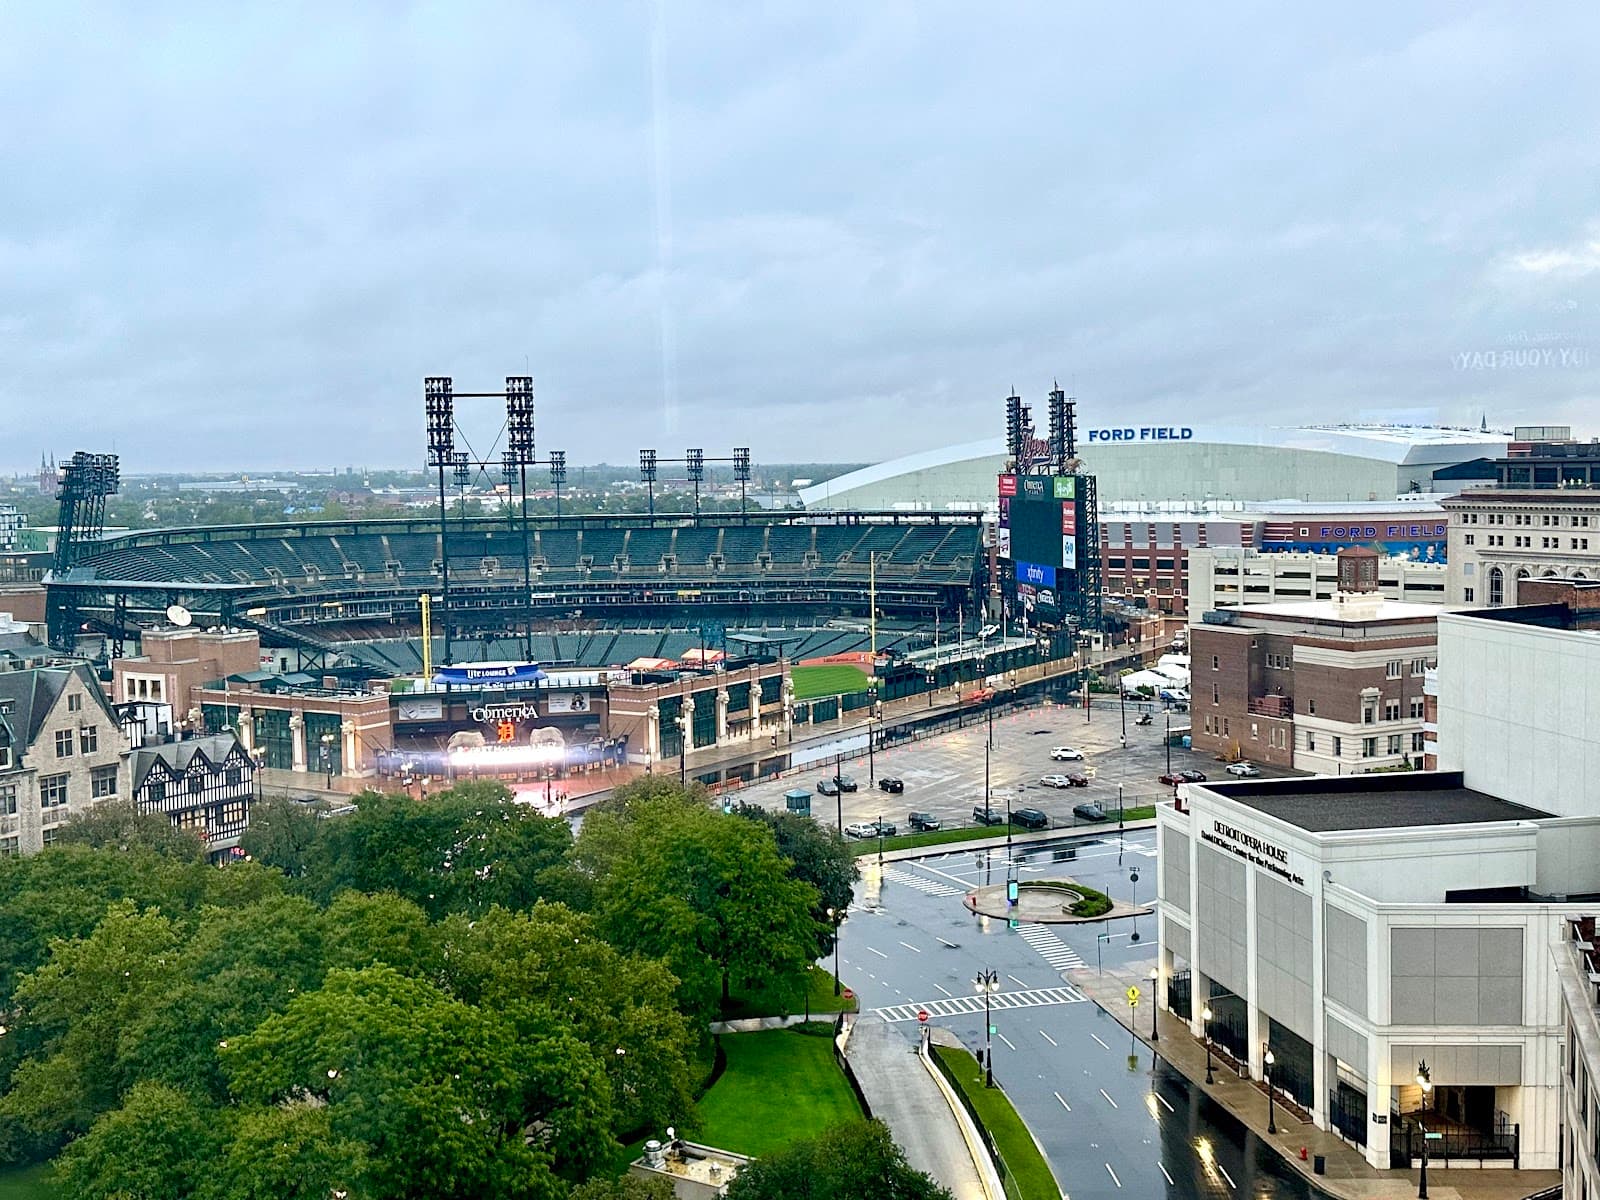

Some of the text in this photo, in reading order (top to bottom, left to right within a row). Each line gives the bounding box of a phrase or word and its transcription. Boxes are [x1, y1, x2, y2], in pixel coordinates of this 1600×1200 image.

[1088, 428, 1193, 441] FORD FIELD
[1320, 525, 1447, 538] FORD FIELD
[481, 669, 507, 677] LOUNGE
[1213, 820, 1288, 864] DETROIT OPERA HOUSE
